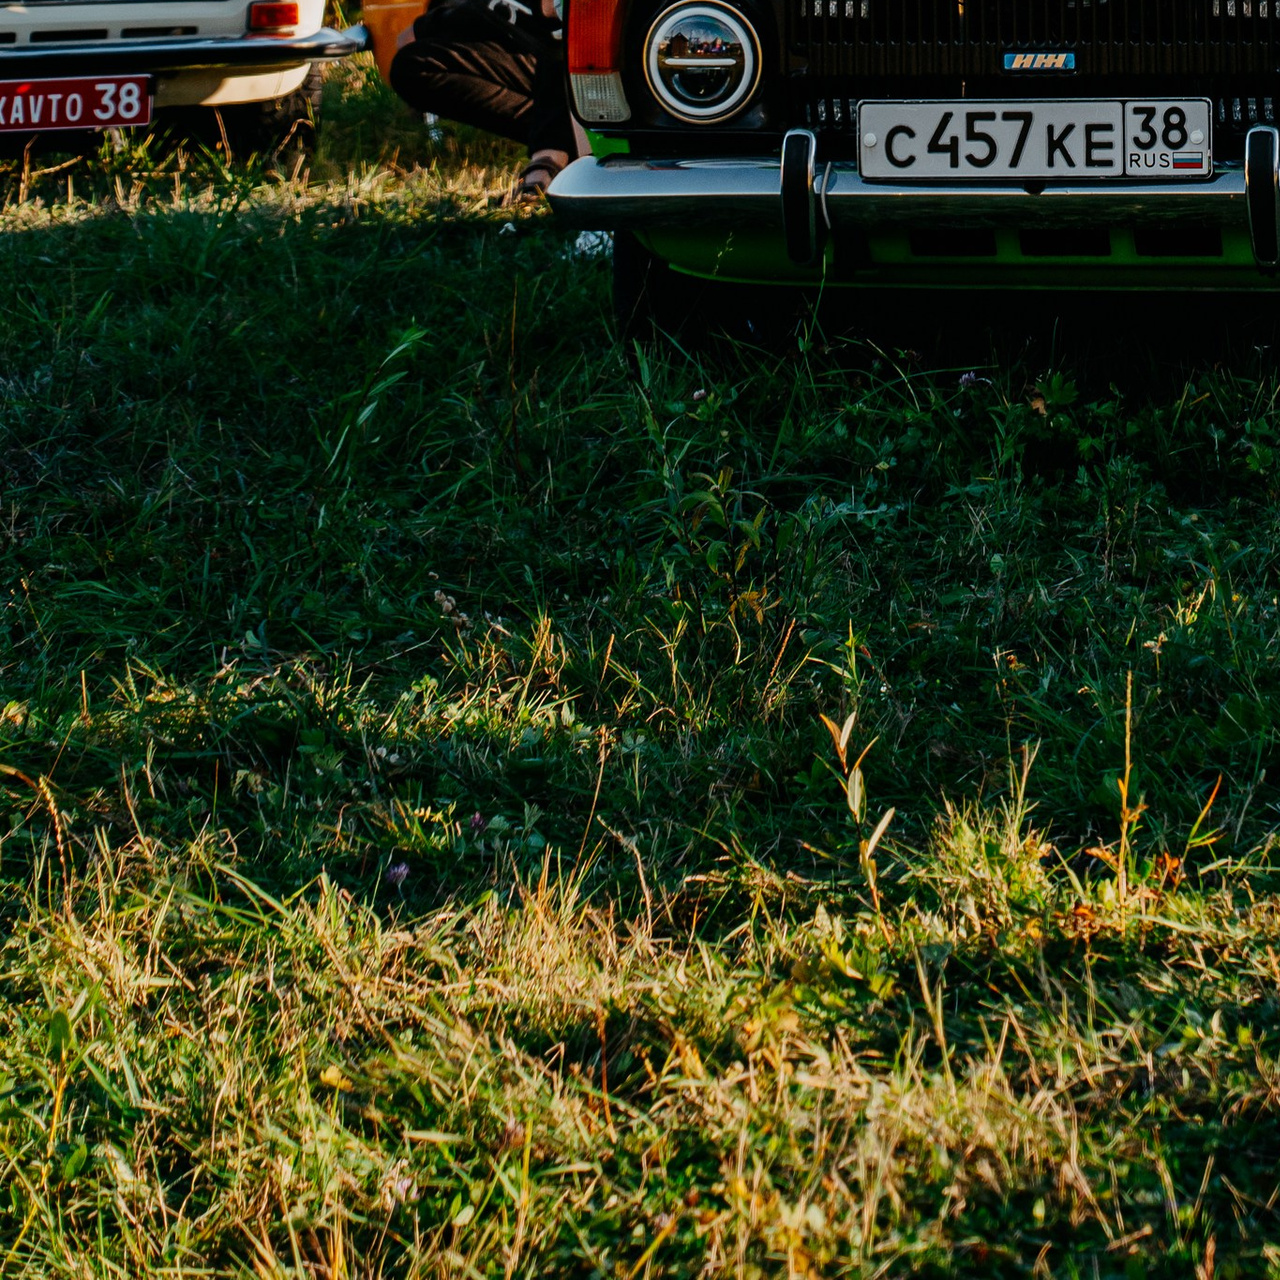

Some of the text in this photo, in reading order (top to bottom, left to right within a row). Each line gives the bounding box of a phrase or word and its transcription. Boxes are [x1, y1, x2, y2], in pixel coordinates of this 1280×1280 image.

[93, 82, 141, 120] 38
[1132, 106, 1188, 151] 38
[1129, 152, 1170, 169] RUS
